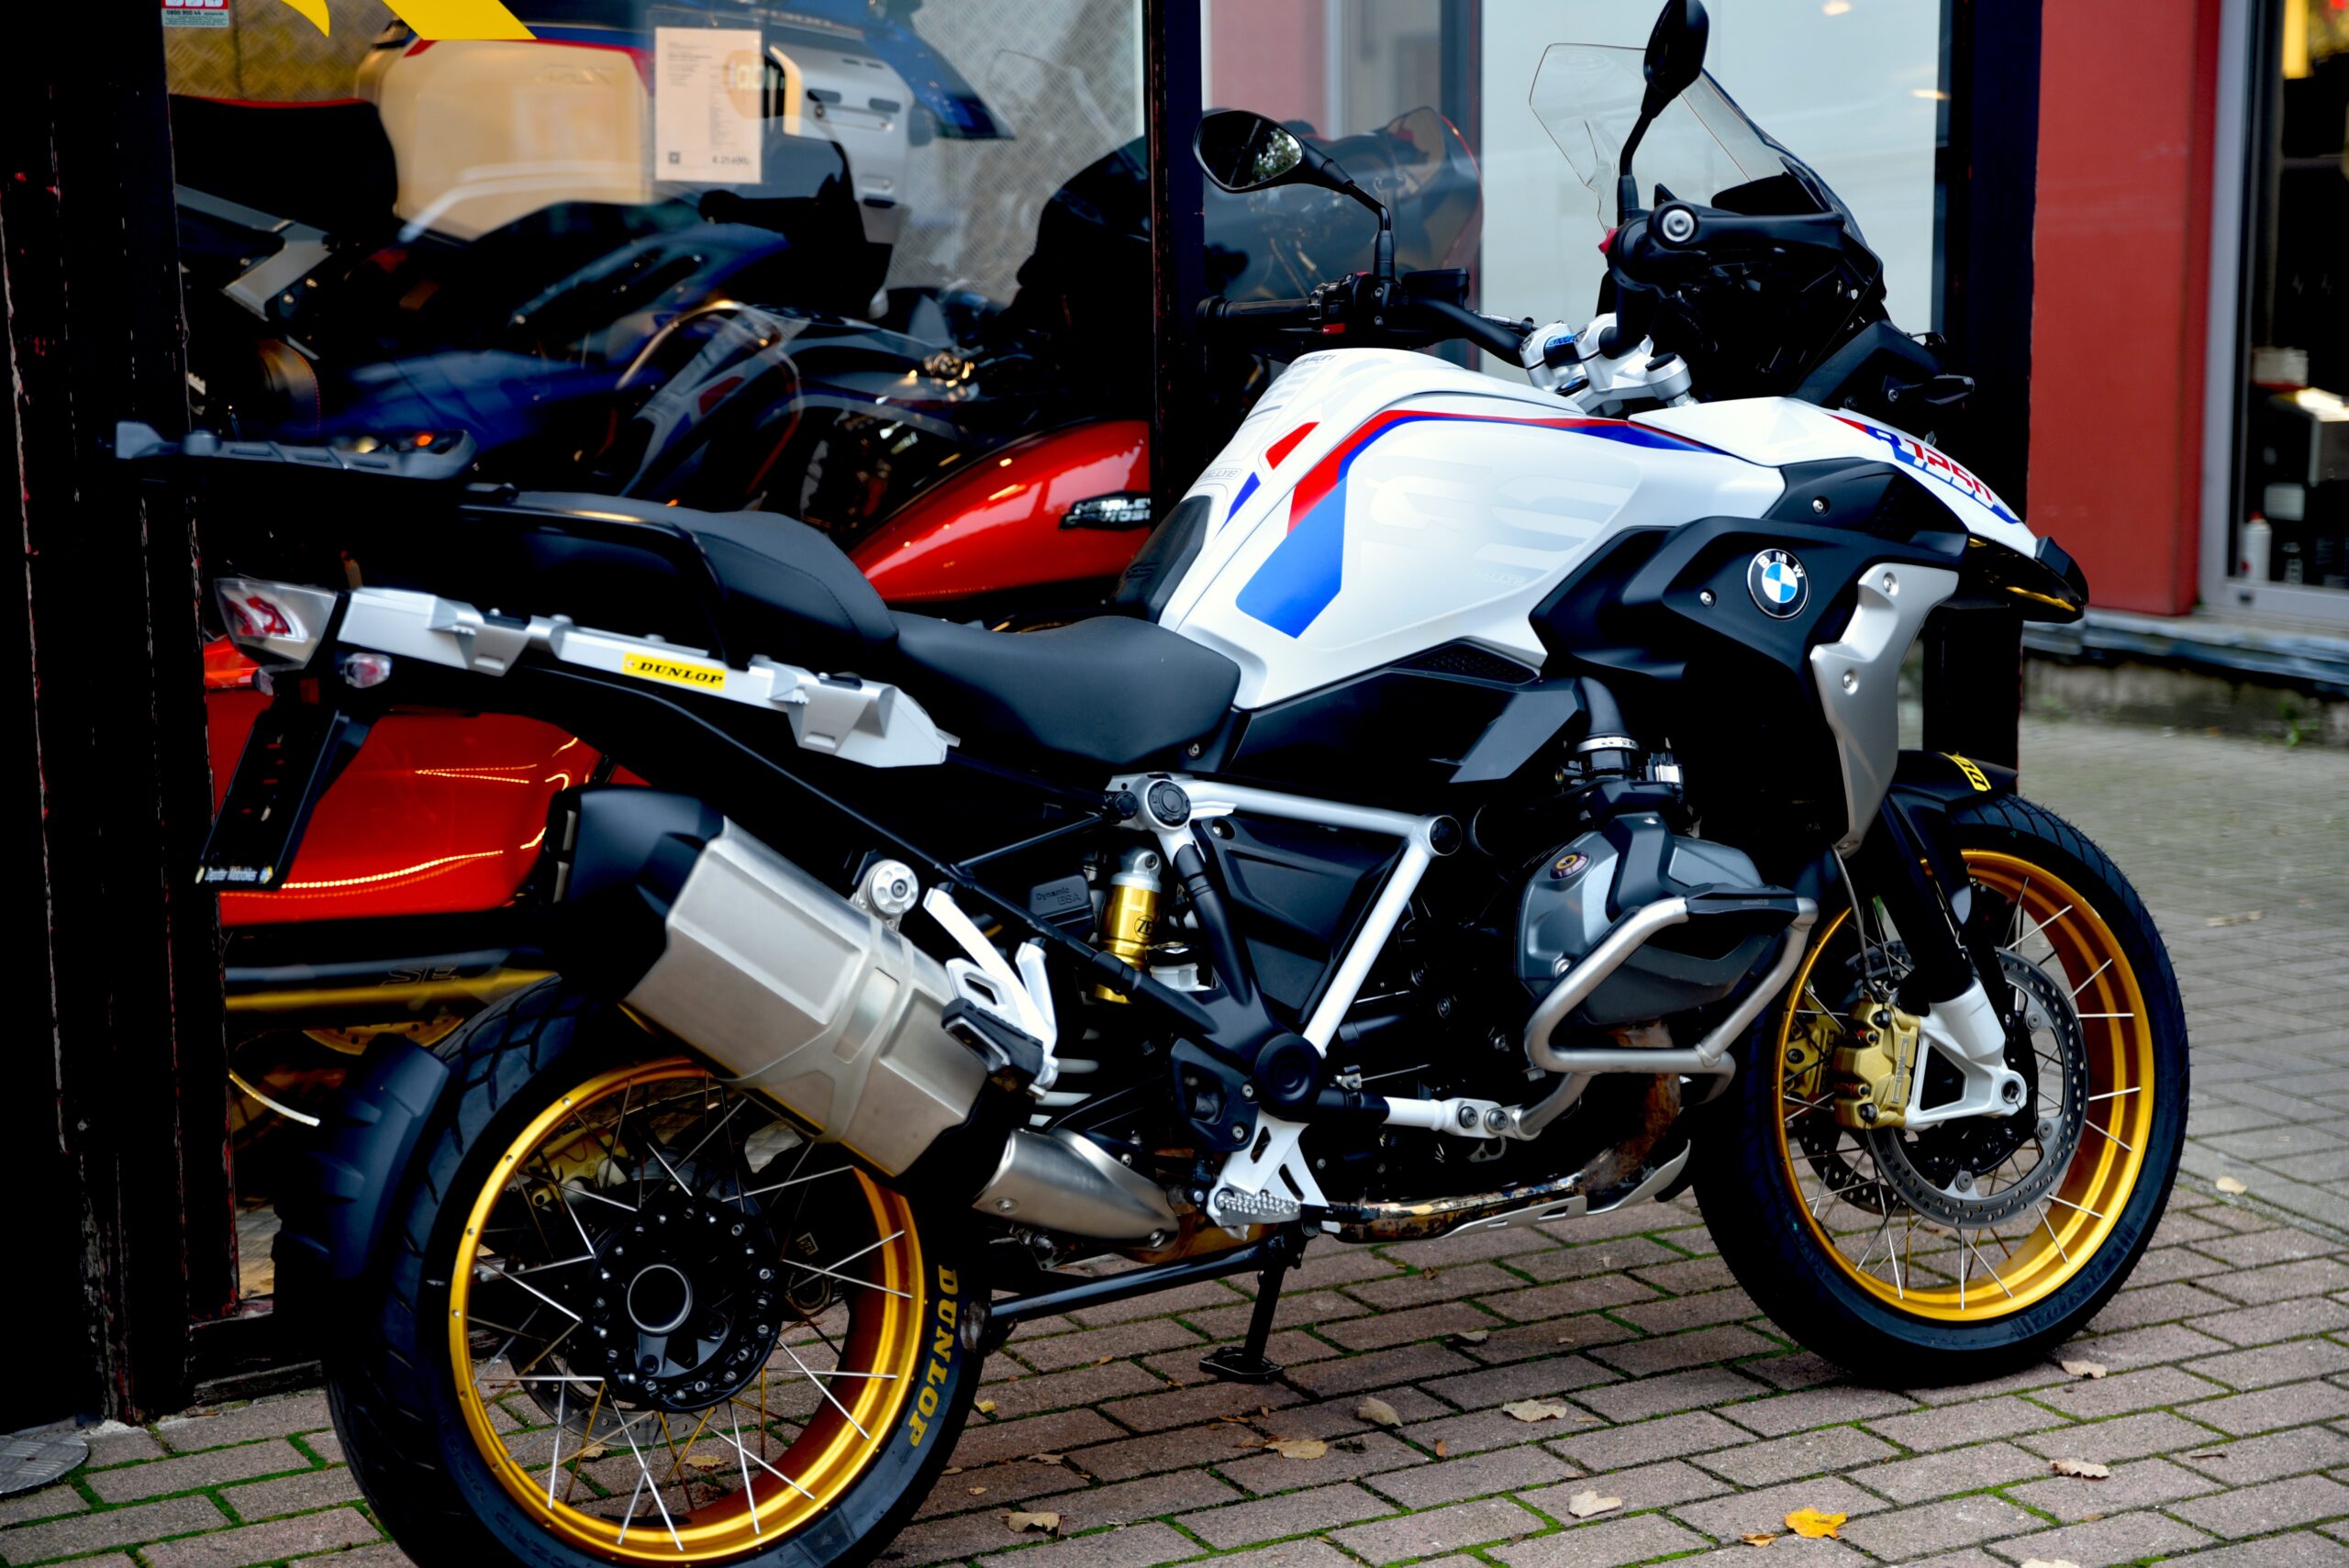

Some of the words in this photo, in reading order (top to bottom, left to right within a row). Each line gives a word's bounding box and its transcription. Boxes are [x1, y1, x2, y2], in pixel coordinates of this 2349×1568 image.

[1757, 551, 1804, 578] BMW
[639, 662, 723, 684] DUNLOP
[1036, 886, 1071, 901] Dynamic
[1056, 894, 1083, 906] ESA
[909, 1264, 959, 1447] DUNLOP
